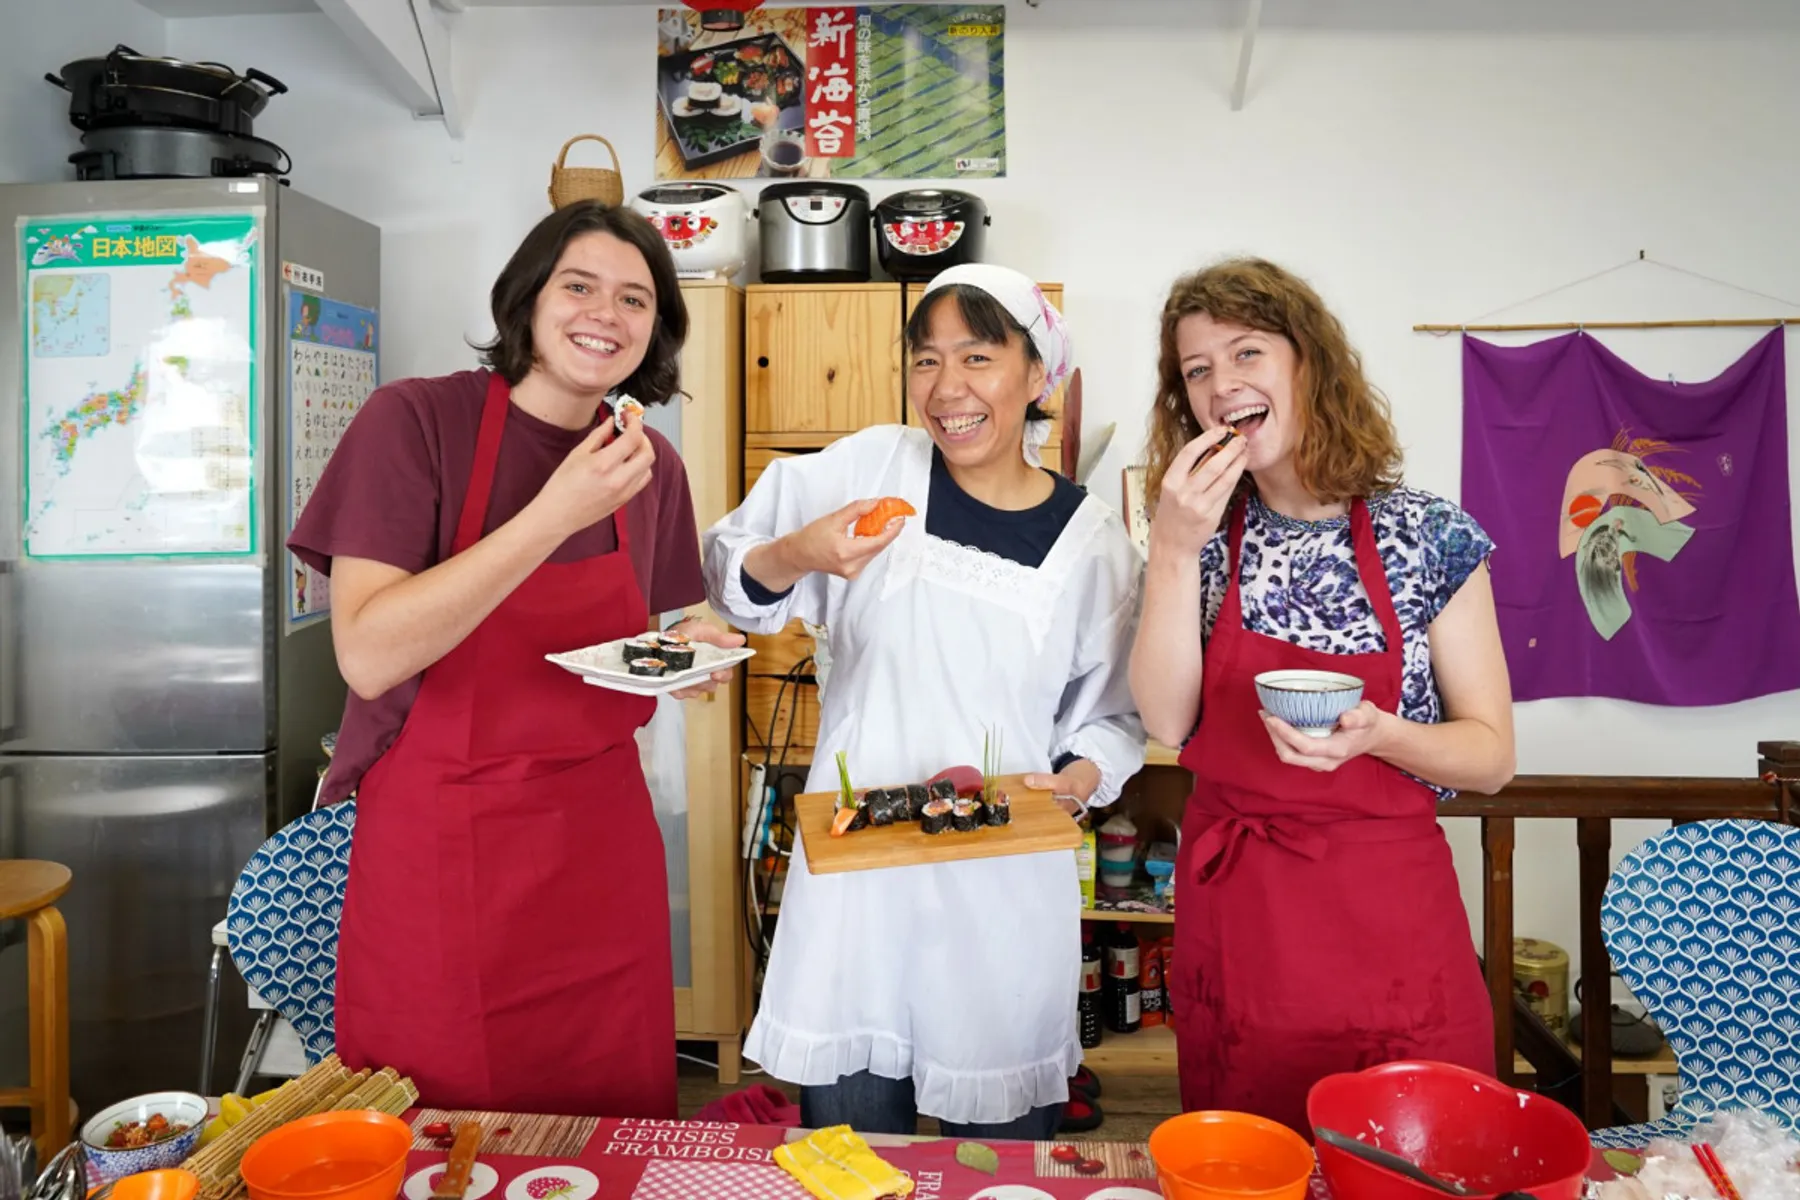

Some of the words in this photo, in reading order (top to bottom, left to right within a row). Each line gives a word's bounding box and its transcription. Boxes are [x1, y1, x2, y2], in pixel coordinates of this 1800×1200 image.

[808, 10, 855, 154] 新海苔
[91, 235, 178, 259] 日本地図
[612, 1127, 737, 1144] CERISES
